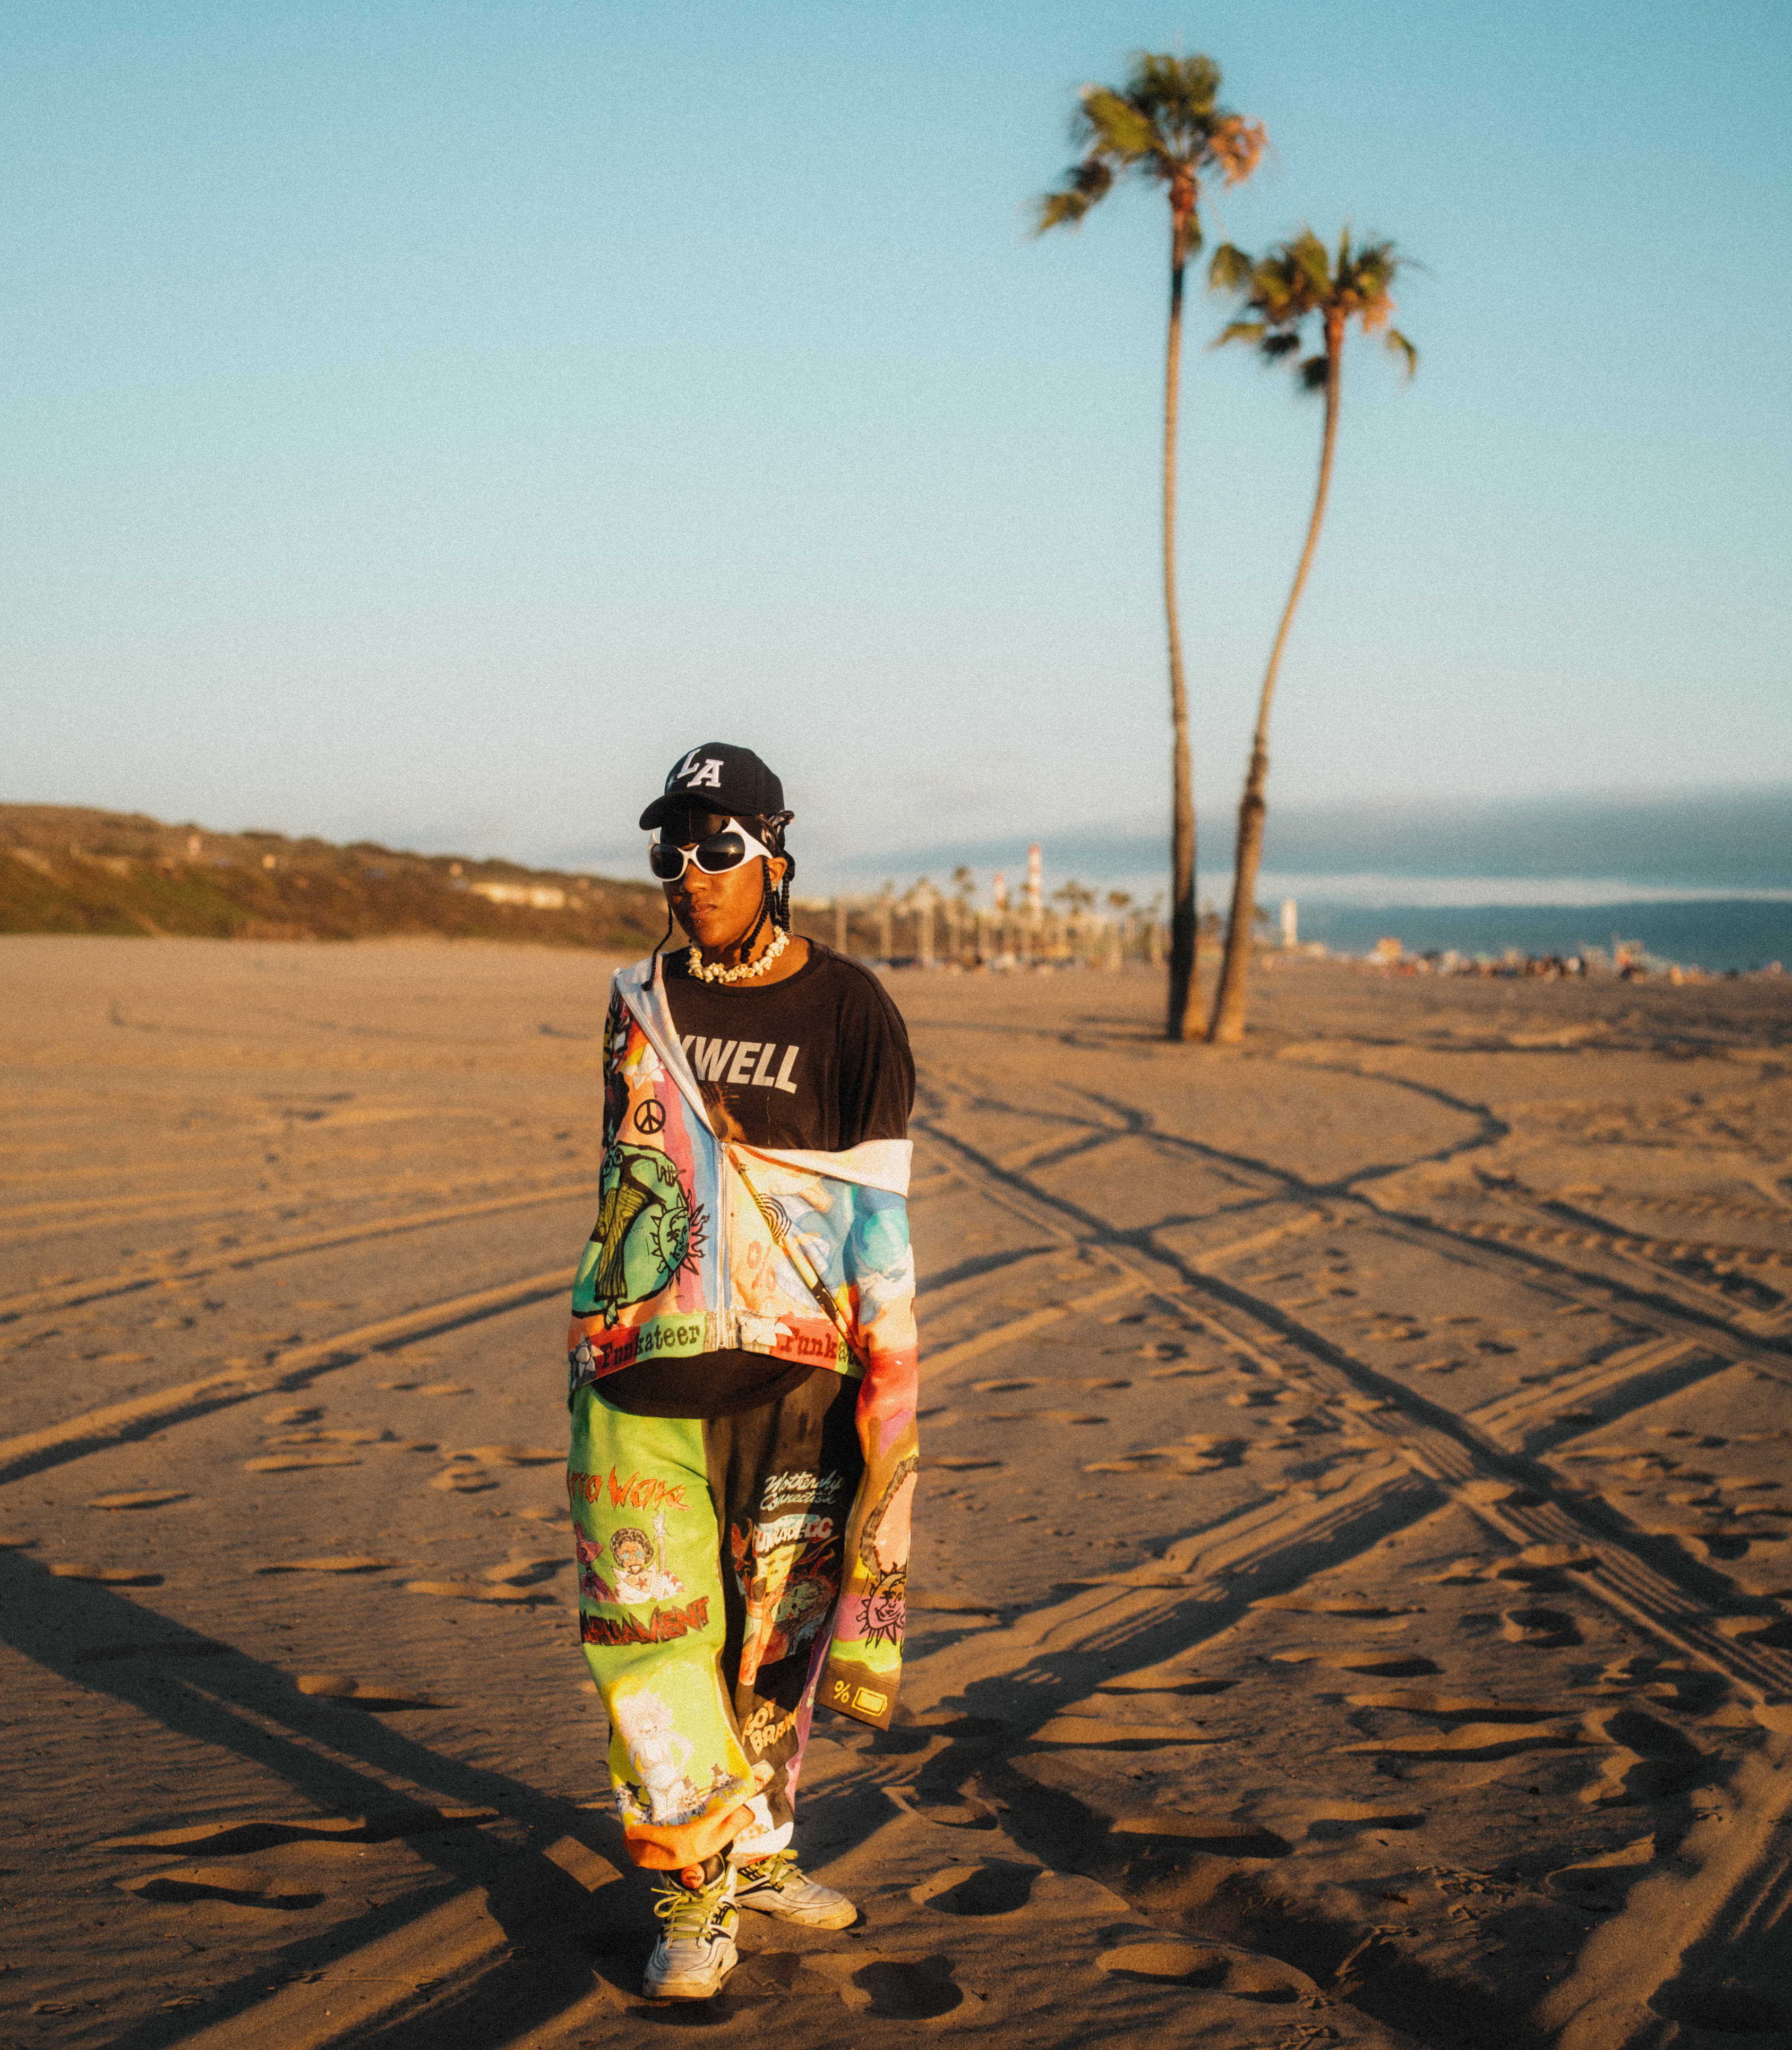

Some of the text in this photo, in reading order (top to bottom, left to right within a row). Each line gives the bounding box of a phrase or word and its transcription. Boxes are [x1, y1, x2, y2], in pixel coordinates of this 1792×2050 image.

[677, 748, 724, 788] LA
[600, 1325, 700, 1370] Funkateer
[578, 1595, 710, 1645] ARLIAMENT
